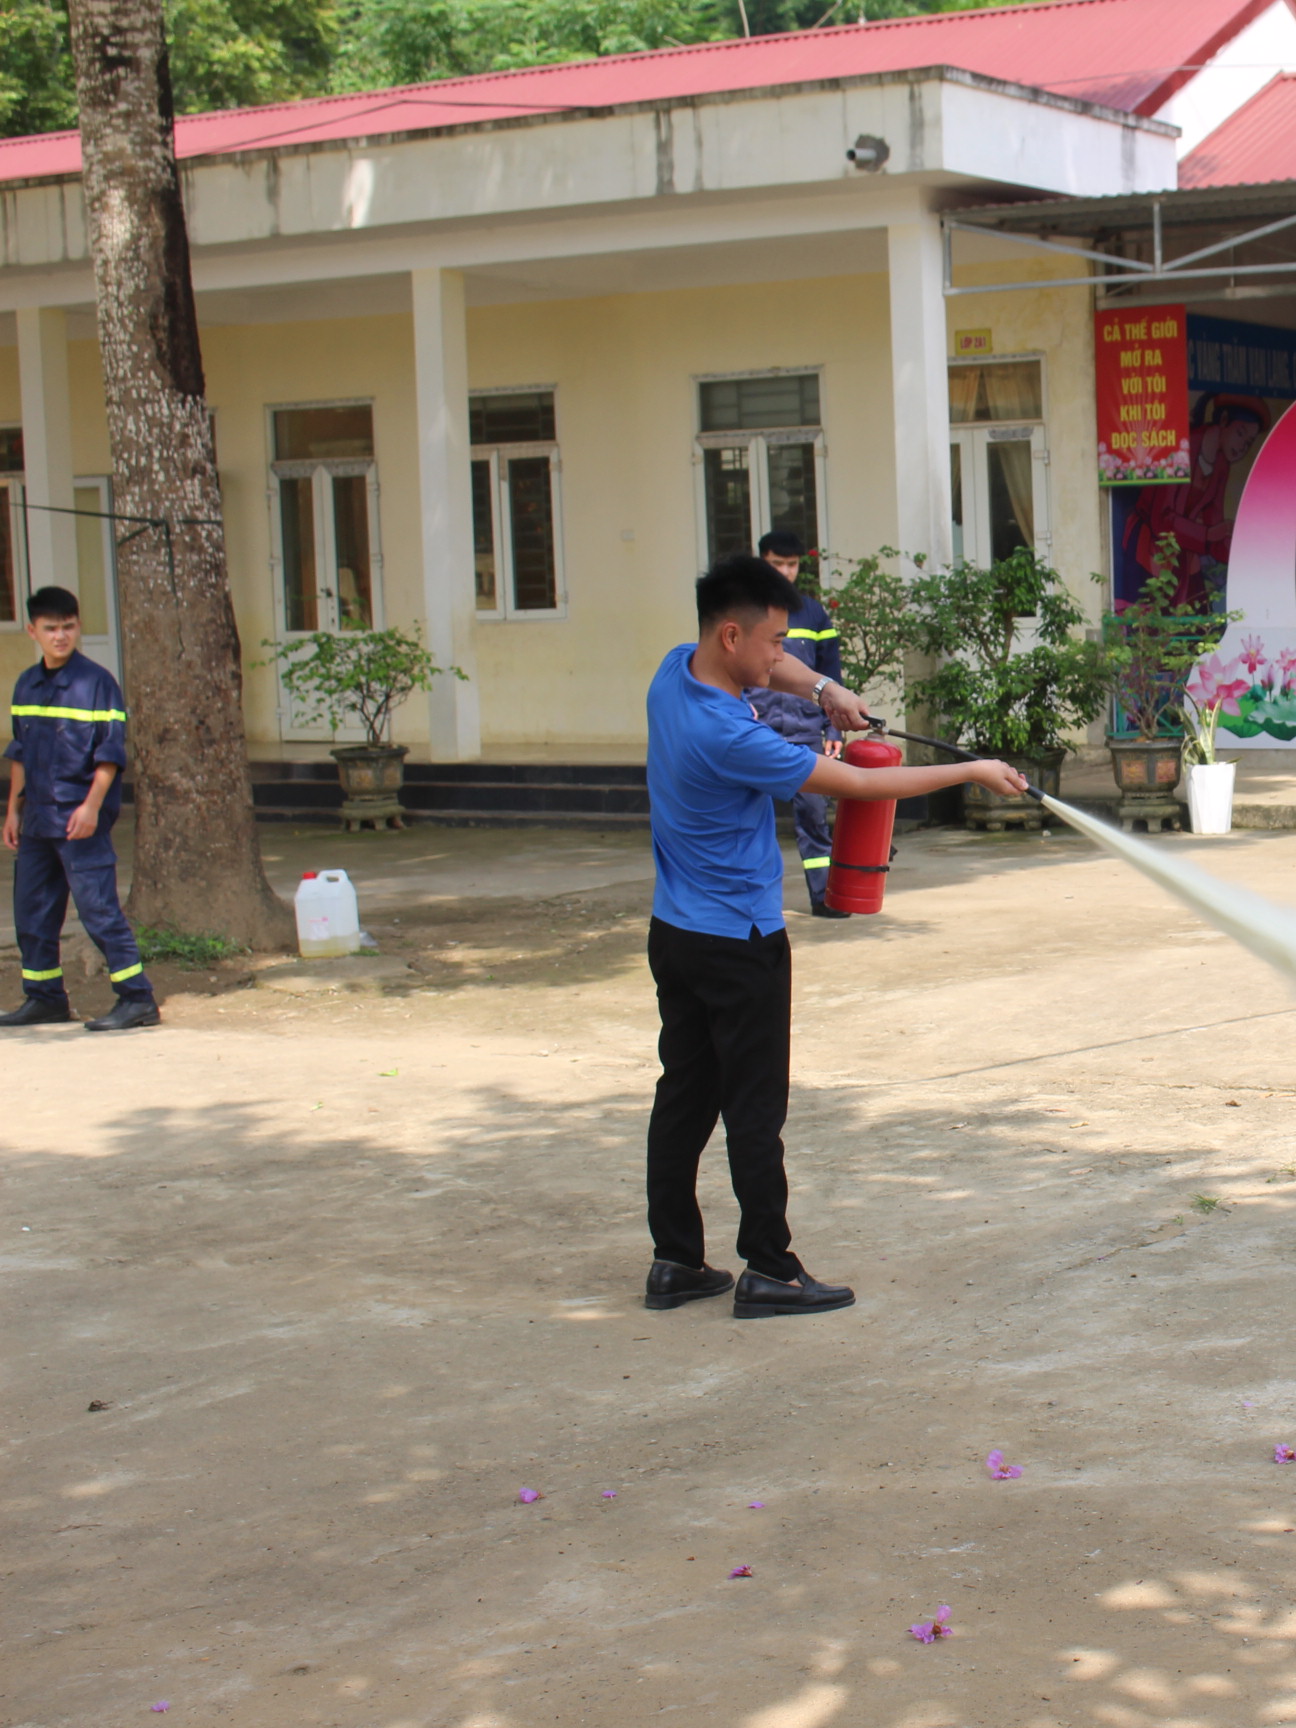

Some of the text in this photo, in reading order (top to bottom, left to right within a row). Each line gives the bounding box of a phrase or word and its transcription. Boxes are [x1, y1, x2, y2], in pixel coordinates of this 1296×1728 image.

[1103, 316, 1178, 342] CẢ THẾ GIỚI
[1120, 343, 1162, 368] MỞ RA
[1122, 373, 1166, 395] VỚI TÔI
[1120, 400, 1165, 422] KHI TÔI
[1111, 428, 1176, 453] ĐỌC SÁCH
